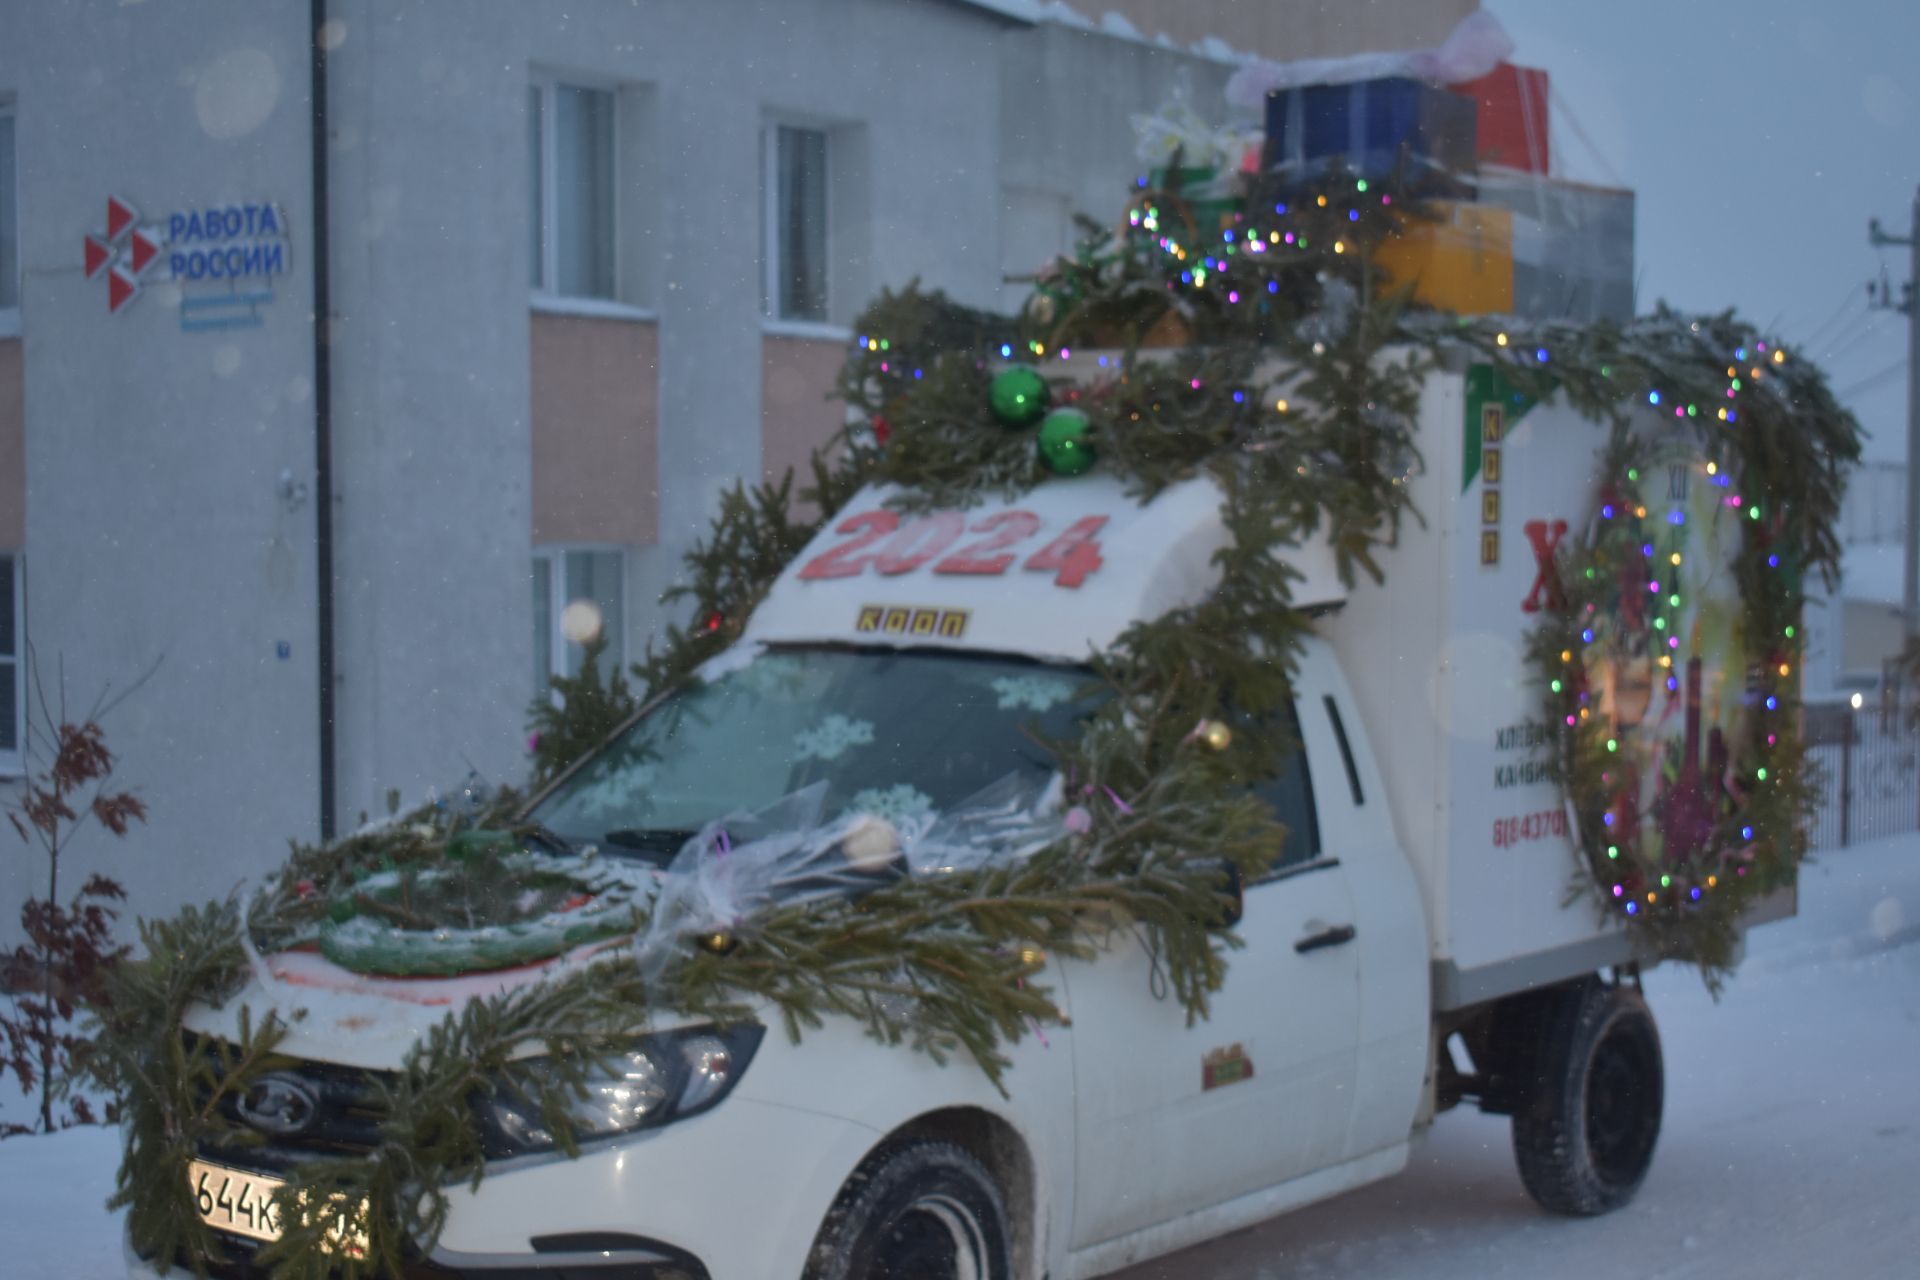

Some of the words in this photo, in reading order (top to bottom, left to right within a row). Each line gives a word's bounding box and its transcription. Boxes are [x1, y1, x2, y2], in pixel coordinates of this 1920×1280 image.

[170, 203, 279, 242] РАБОТА
[170, 243, 283, 280] РОССИИ
[797, 508, 1111, 589] 2024
[1521, 519, 1569, 612] Х
[198, 1172, 275, 1234] 644К
